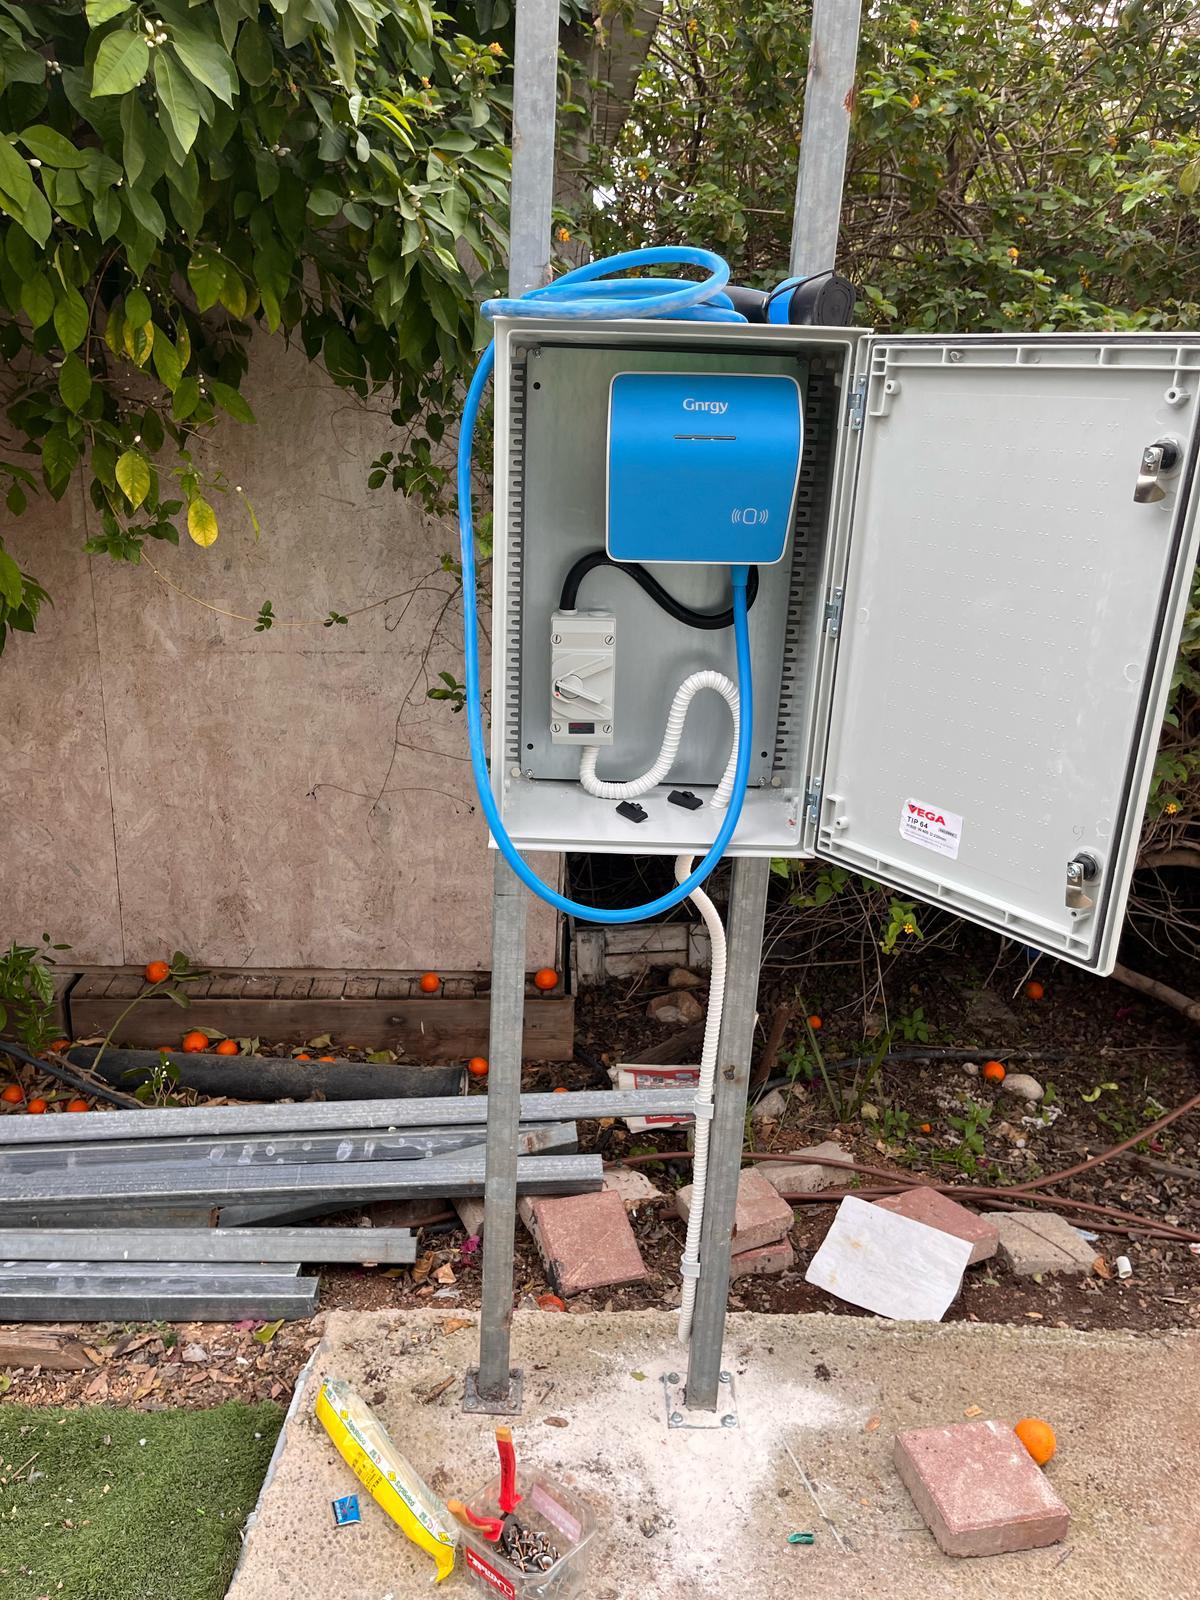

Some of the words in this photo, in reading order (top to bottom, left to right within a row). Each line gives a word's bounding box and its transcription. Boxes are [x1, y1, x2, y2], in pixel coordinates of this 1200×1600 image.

[682, 398, 729, 414] Gnrgy
[907, 816, 919, 824] TIP
[920, 821, 928, 829] 64
[908, 804, 946, 826] VEGA
